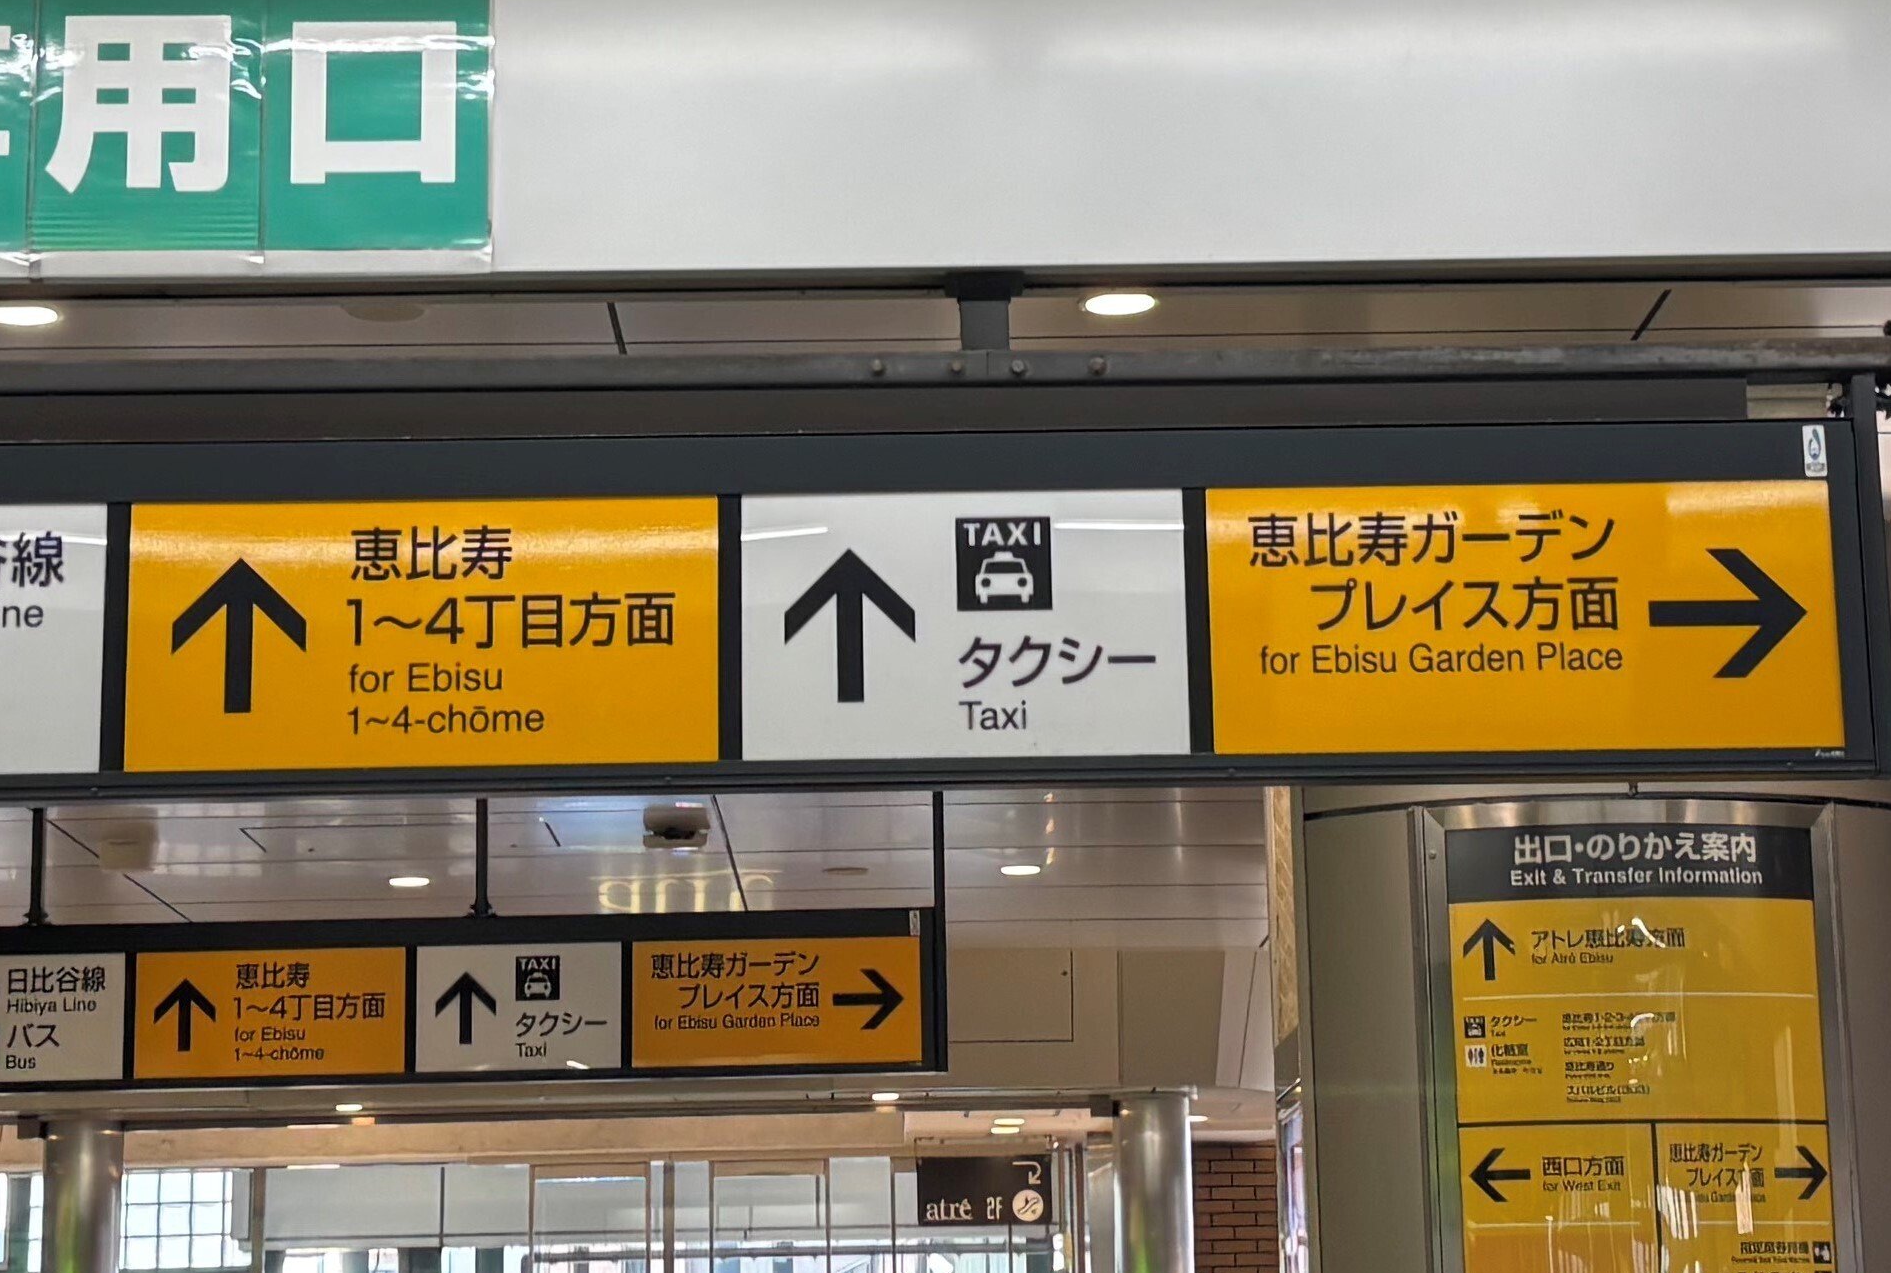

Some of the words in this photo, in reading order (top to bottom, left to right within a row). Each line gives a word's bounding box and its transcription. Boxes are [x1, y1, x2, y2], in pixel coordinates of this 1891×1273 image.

[964, 523, 1041, 545] TAXI
[1249, 513, 1614, 566] 恵比寿ガーデン
[349, 525, 513, 582] 恵比寿
[1312, 576, 1619, 633] プレイス方面
[959, 638, 1156, 686] タクシー
[1259, 647, 1300, 674] for
[1312, 645, 1399, 674] Ebisu
[1409, 643, 1528, 672] Garden
[1538, 641, 1623, 672] Place
[349, 664, 399, 693] for
[407, 662, 503, 692] Ebisu
[959, 700, 1027, 730] Taxi
[1514, 833, 1756, 864] 出口・のりかえ案内
[1511, 869, 1547, 885] Exit
[1554, 870, 1565, 884] &
[1574, 868, 1653, 885] Transfer
[1659, 867, 1762, 885] Information
[235, 962, 309, 989] 恵比寿
[519, 958, 558, 971] TAXI
[650, 952, 819, 980] 恵比寿ガーデン
[7, 966, 106, 995] 日比谷線
[7, 997, 56, 1015] Hibiya
[62, 997, 97, 1013] Line
[679, 982, 819, 1010] プレイス方面
[514, 1011, 608, 1037] タクシー
[653, 1015, 672, 1031] for
[677, 1014, 718, 1031] Ebisu
[723, 1013, 776, 1029] Garden
[781, 1012, 819, 1028] Place
[1491, 1016, 1537, 1026] タクシー
[7, 1024, 60, 1048] バス
[234, 1027, 256, 1043] for
[261, 1026, 306, 1043] Ebisu
[6, 1054, 36, 1070] Bus
[515, 1042, 548, 1058] Taxi
[1542, 1156, 1624, 1177] 西口方面
[1563, 1180, 1594, 1192] West
